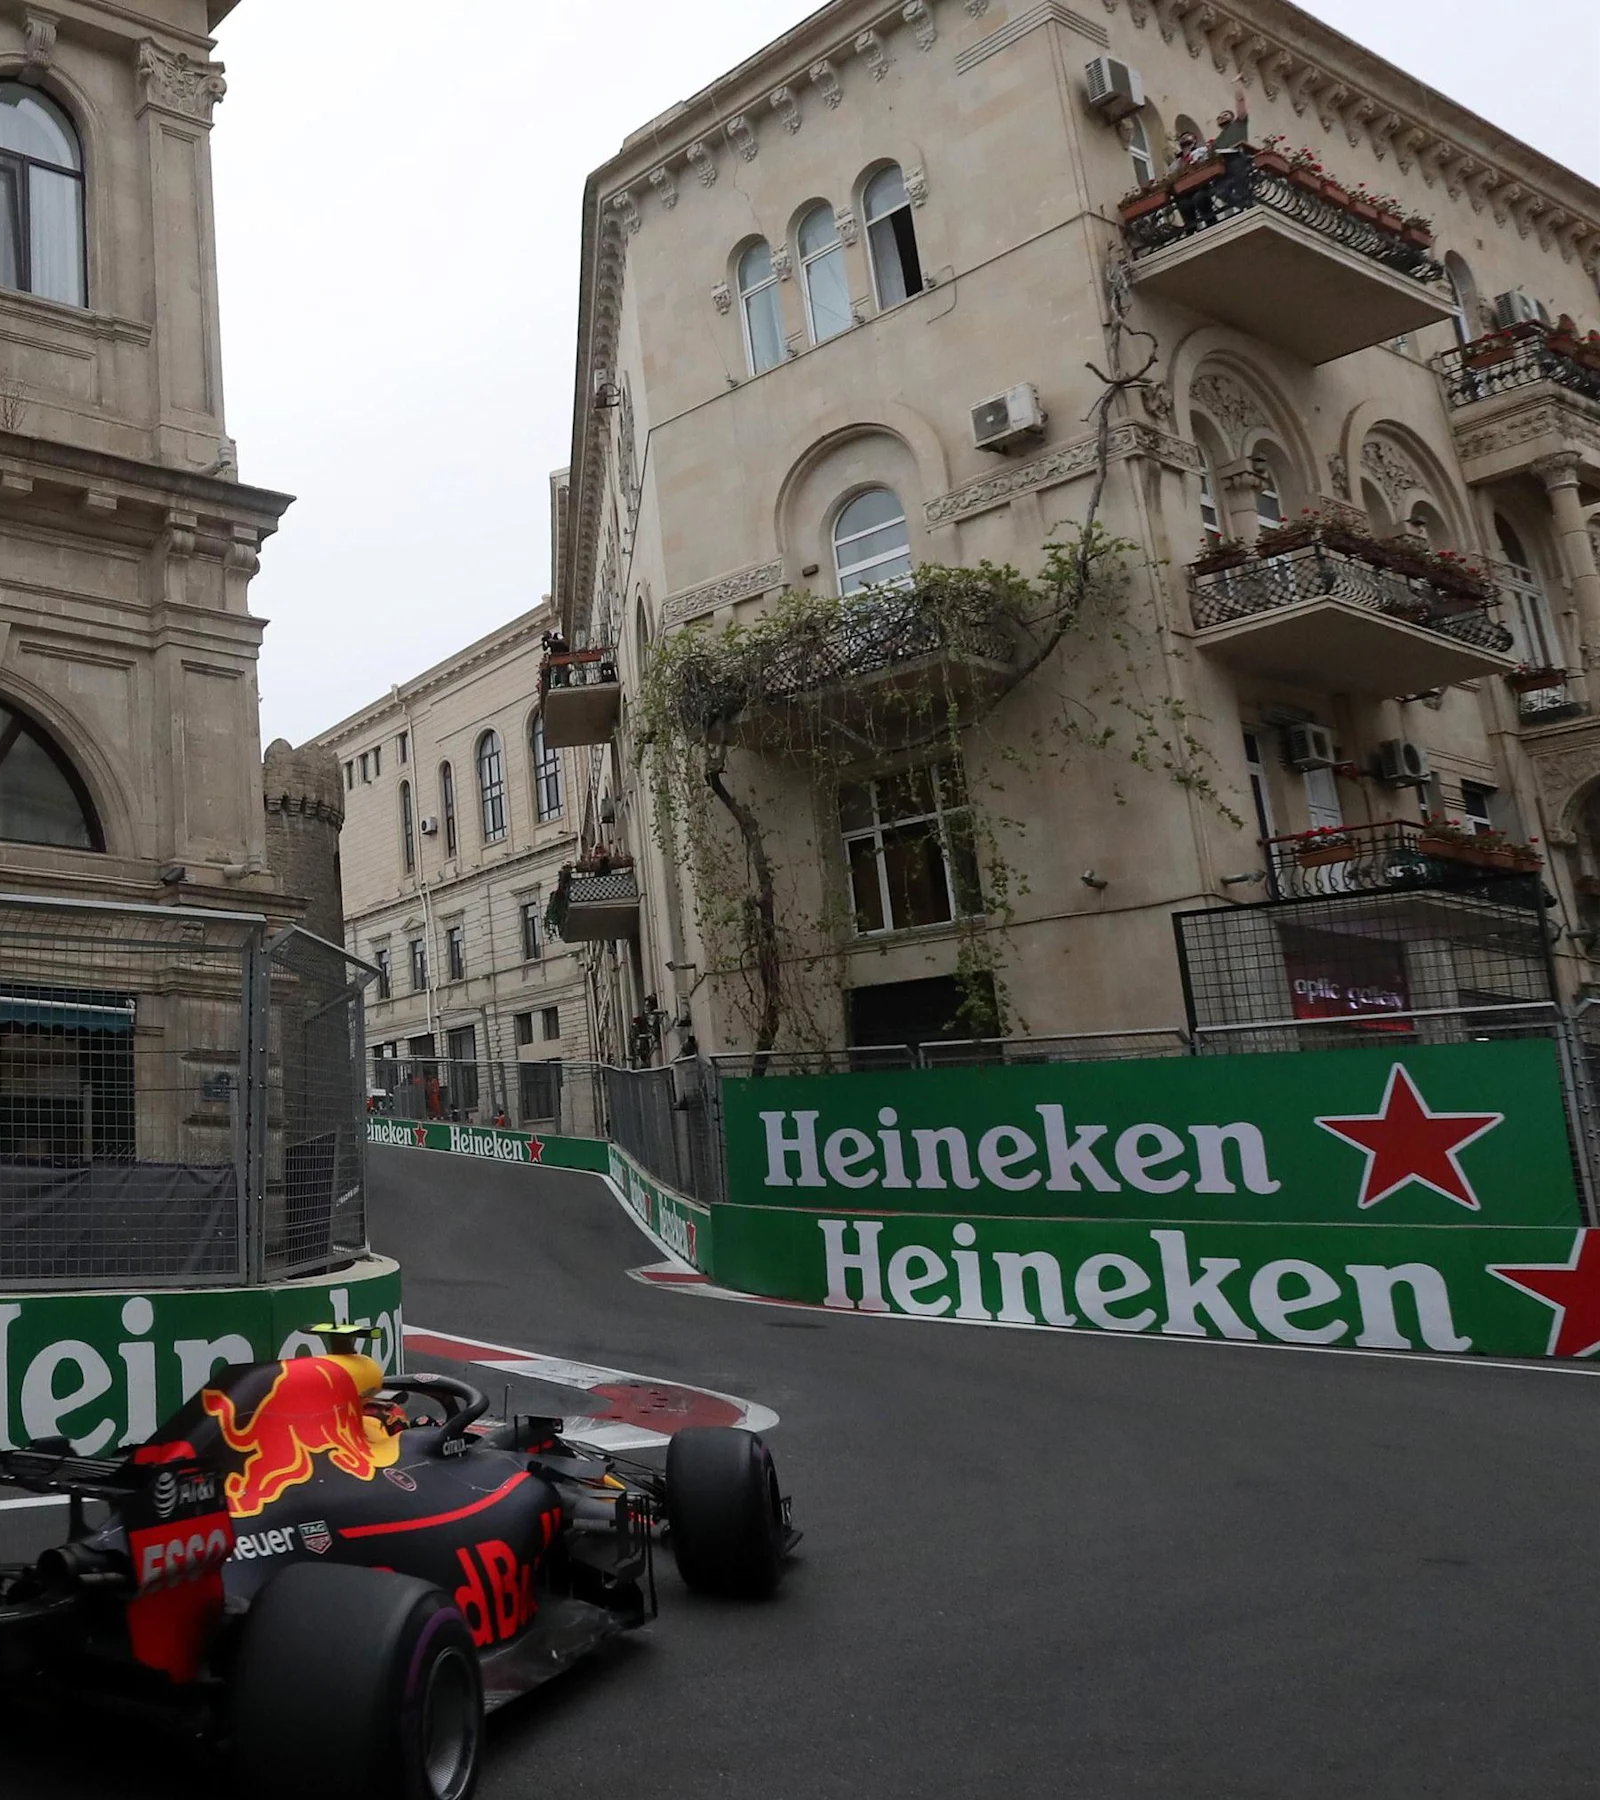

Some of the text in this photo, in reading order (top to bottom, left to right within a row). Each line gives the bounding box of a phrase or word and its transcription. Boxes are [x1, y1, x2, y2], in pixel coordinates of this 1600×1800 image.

[450, 1126, 524, 1161] Heineken
[758, 1103, 1281, 1196] Heineken
[818, 1219, 1473, 1353] Heineken
